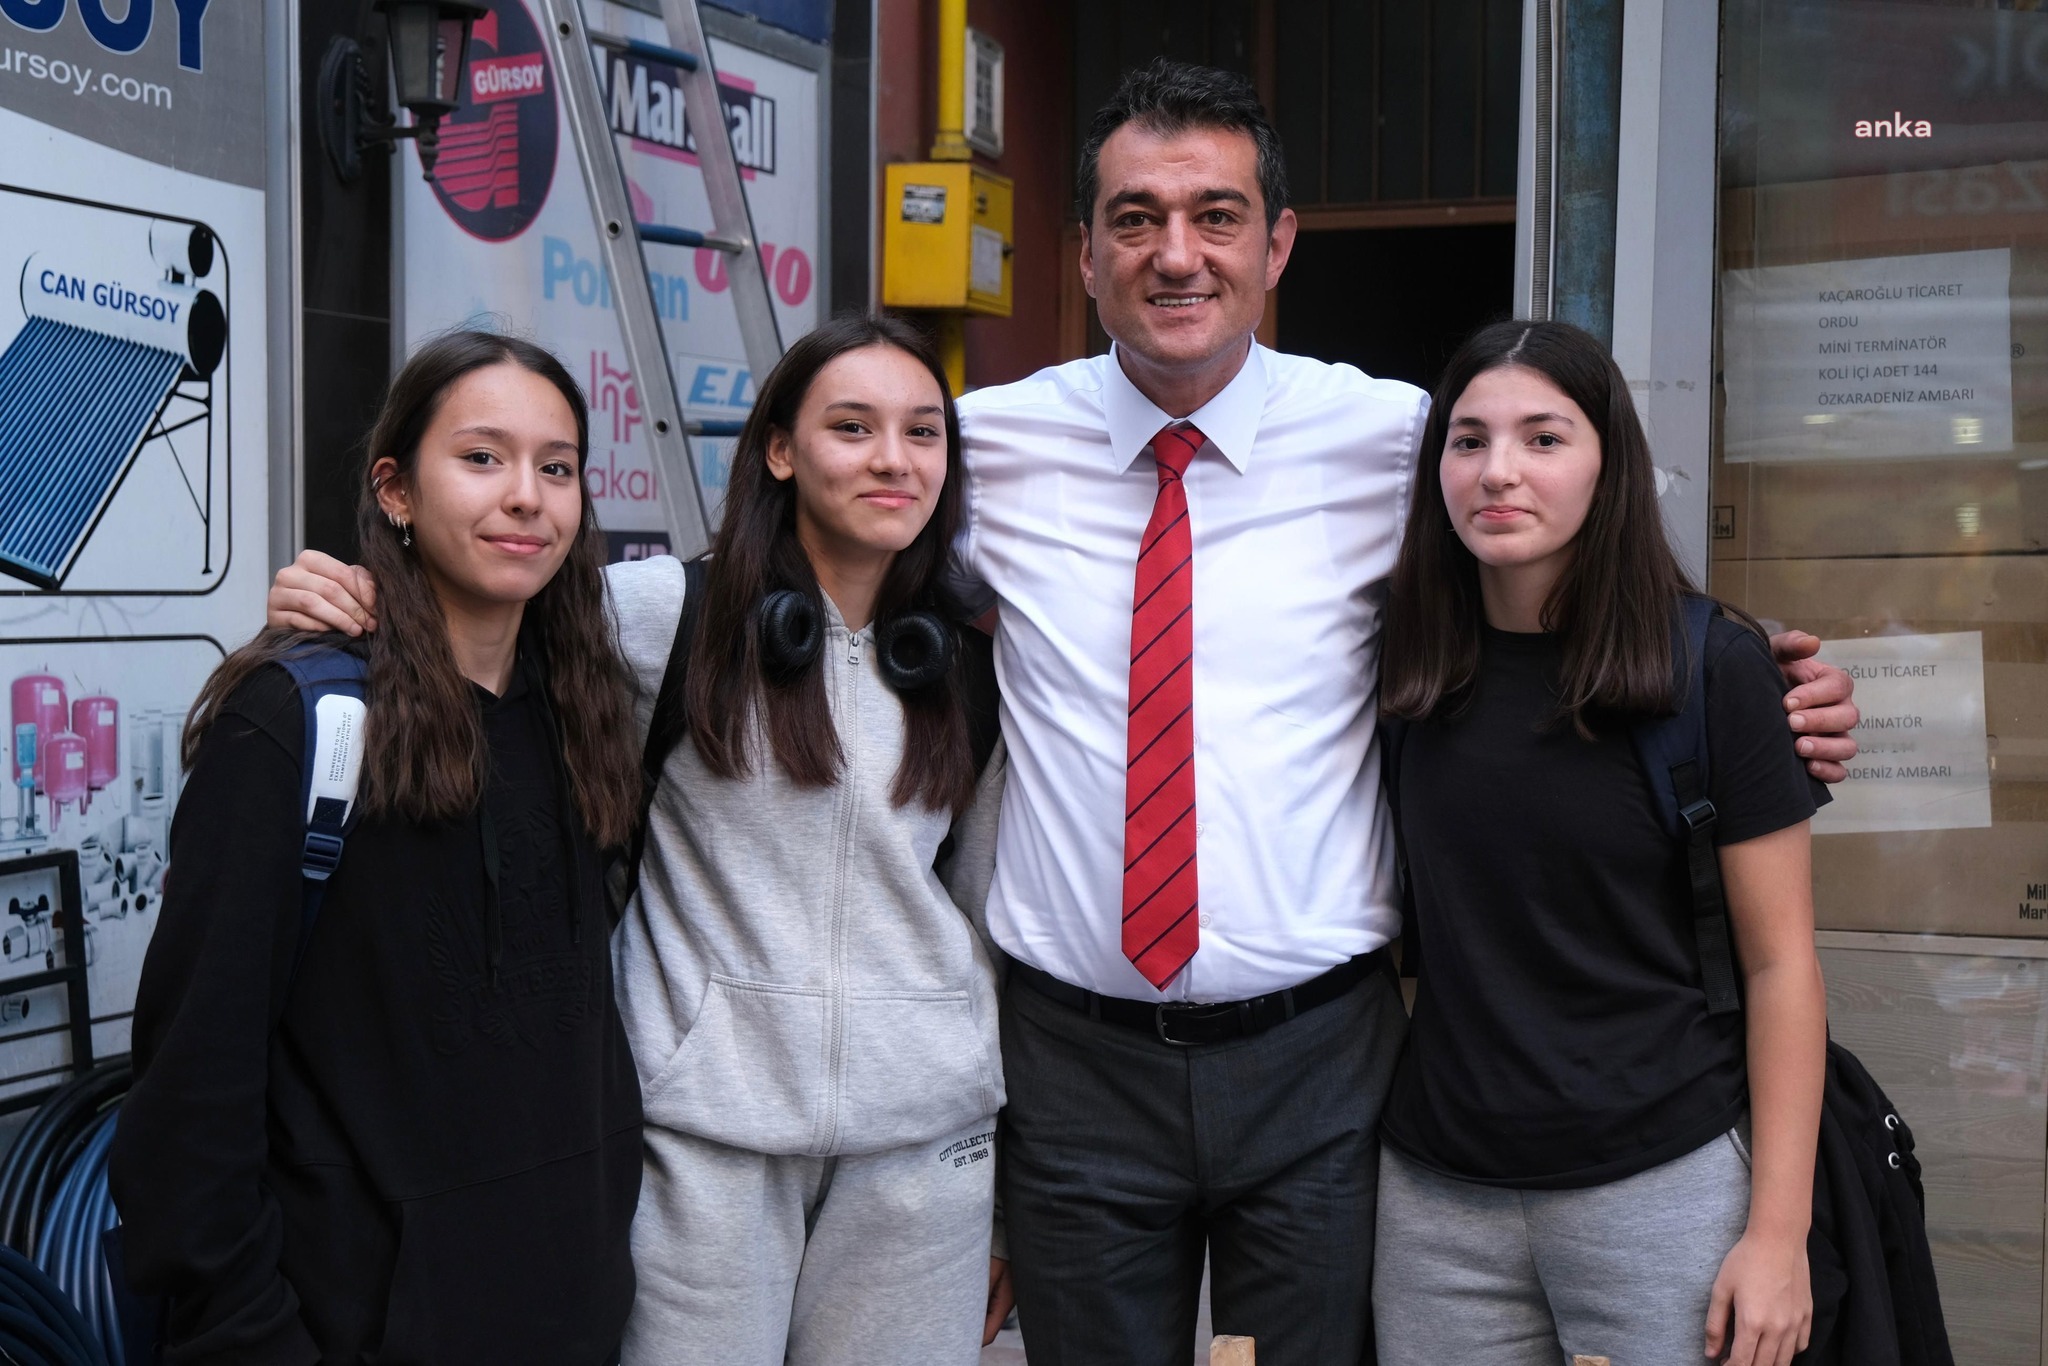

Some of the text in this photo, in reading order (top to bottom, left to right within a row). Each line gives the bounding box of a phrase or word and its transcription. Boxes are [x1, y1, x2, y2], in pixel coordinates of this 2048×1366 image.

[474, 63, 544, 96] GÜRSOY
[611, 58, 773, 170] Marall
[543, 235, 689, 322] Polan
[40, 269, 179, 323] CAN GÜRSOY
[1818, 283, 1963, 304] KAÇAROĞLU TİCARET
[1818, 316, 1858, 329] ORDU
[1818, 335, 1947, 354] MİNİ TERMİNATÖR
[1818, 364, 1938, 381] KOLİ İÇİ ADET 144
[1818, 388, 1974, 406] ÖZKARADENİZ AMBARI
[1882, 664, 1937, 678] TİCARET
[1853, 714, 1923, 730] MİNATÖR
[1896, 765, 1951, 778] AMBARI
[2027, 883, 2048, 900] Mil
[2019, 903, 2048, 920] Mar
[939, 1145, 953, 1161] CITY
